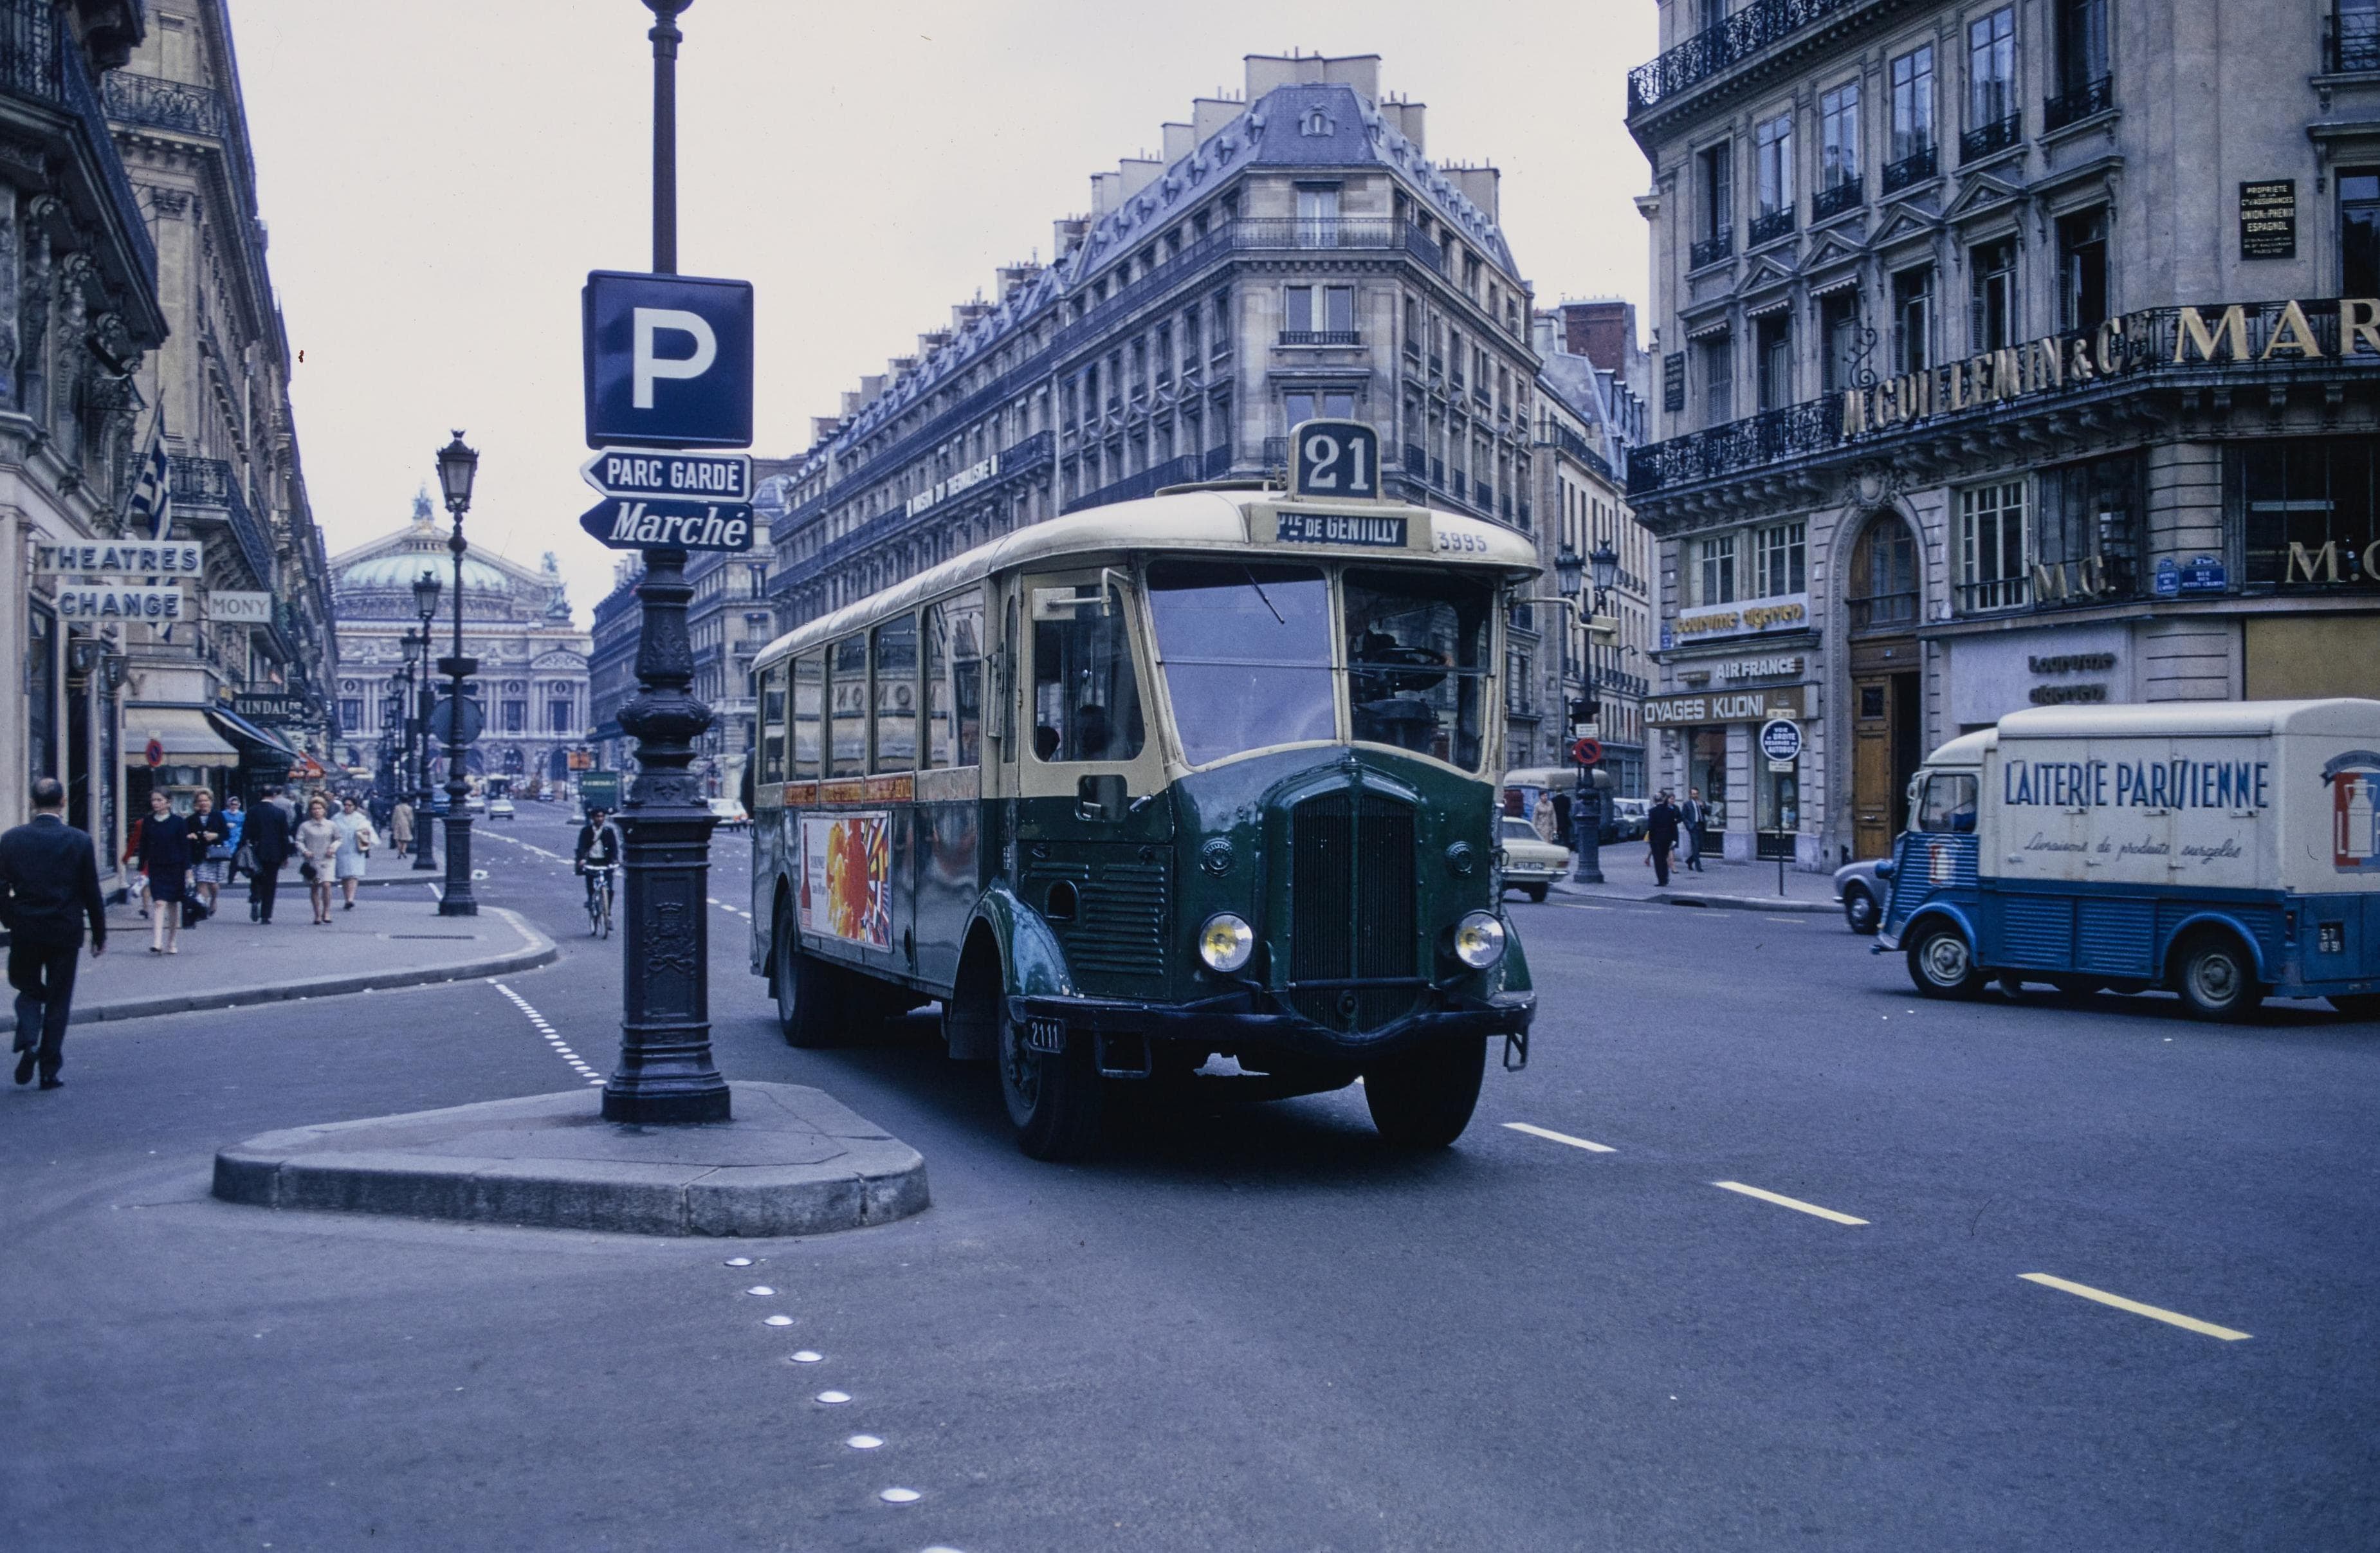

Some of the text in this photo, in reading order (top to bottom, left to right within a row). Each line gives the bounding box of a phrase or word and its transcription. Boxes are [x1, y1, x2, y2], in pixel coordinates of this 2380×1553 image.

[2247, 221, 2289, 232] ESPAGNOL
[632, 307, 717, 409] P
[2071, 338, 2093, 381] &
[607, 457, 663, 488] PARC
[1304, 434, 1369, 490] 21
[608, 501, 748, 547] Marché
[1305, 518, 1323, 537] DE
[1326, 518, 1400, 544] GENTILLY
[1437, 531, 1488, 553] 3995
[39, 547, 198, 572] THEATRES
[59, 592, 179, 617] CHANGE
[212, 597, 269, 616] MONY
[1716, 657, 1796, 679] AIR FRANCE
[1712, 694, 1764, 719] KUONI
[2005, 760, 2109, 807] LAITERIE
[2096, 836, 2111, 854] de
[2116, 835, 2171, 862] produits
[2181, 829, 2242, 865] surgelés
[1032, 1021, 1058, 1049] 2111
